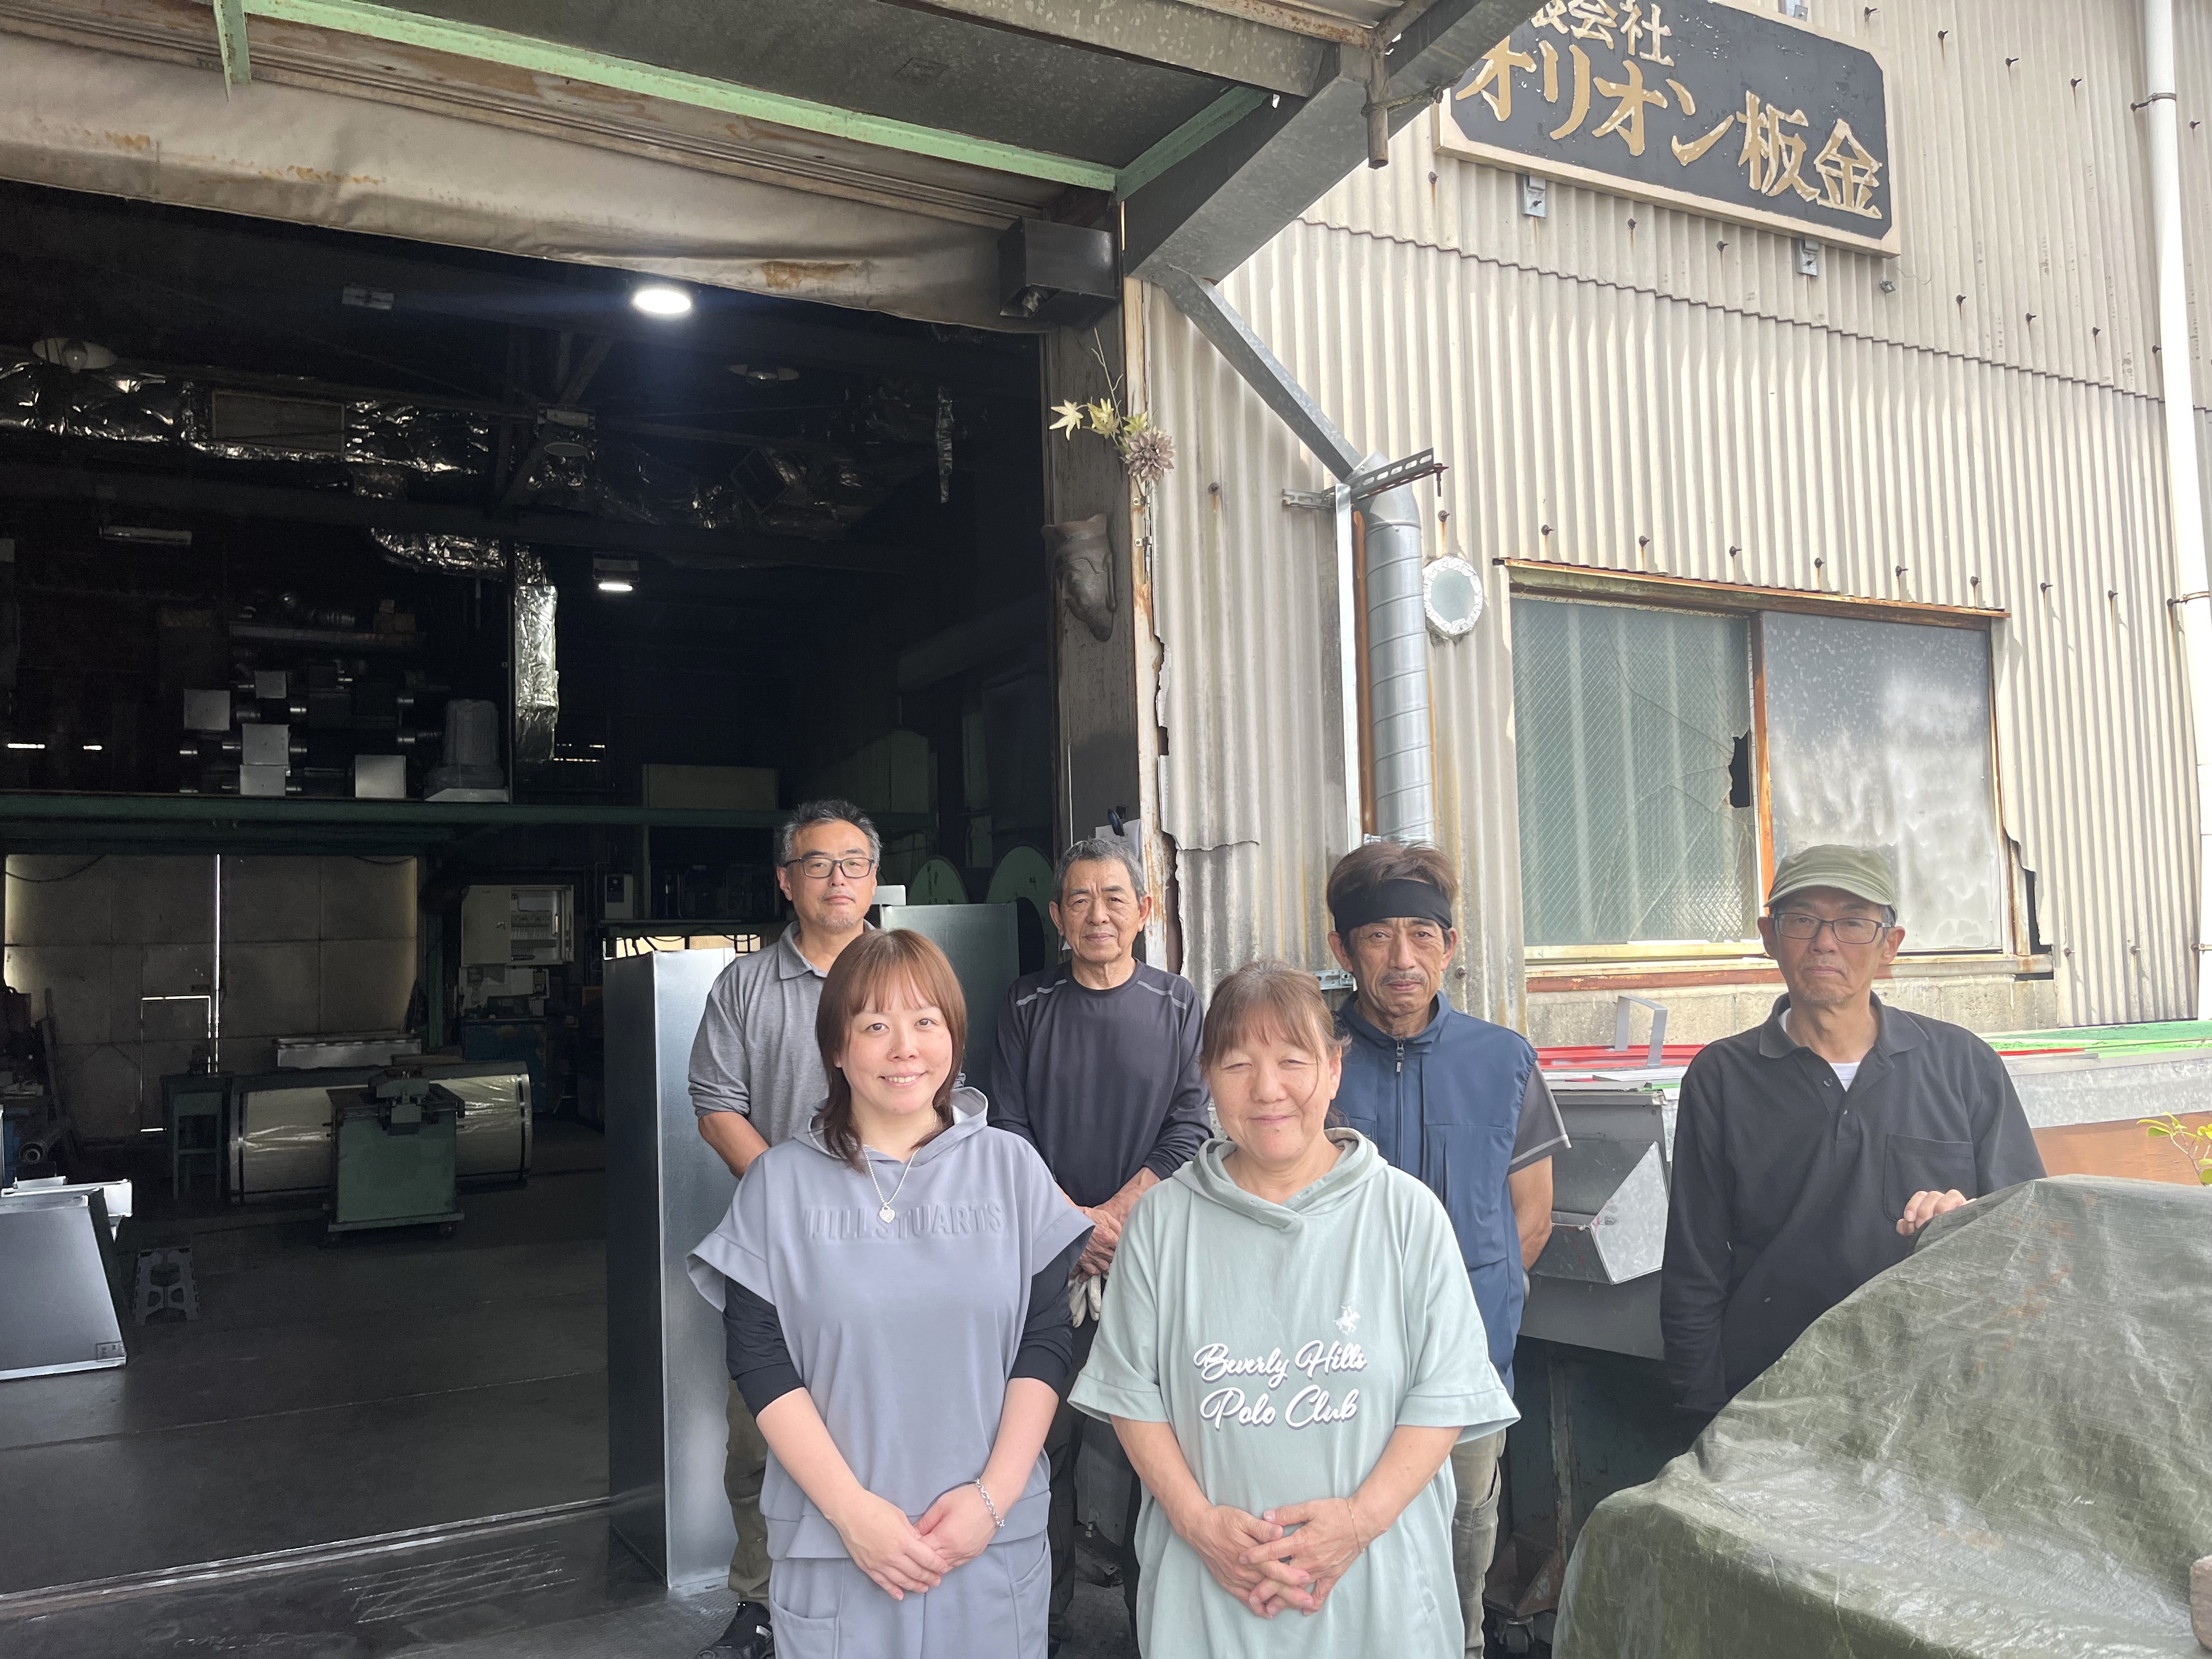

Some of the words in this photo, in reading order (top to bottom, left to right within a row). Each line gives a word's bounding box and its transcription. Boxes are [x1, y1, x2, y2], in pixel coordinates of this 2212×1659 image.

[1455, 35, 1883, 219] オリオン板金
[1193, 1343, 1289, 1389] Beverly
[1295, 1340, 1367, 1378] Hills
[1200, 1387, 1276, 1429] Polo
[1285, 1384, 1359, 1429] Club
